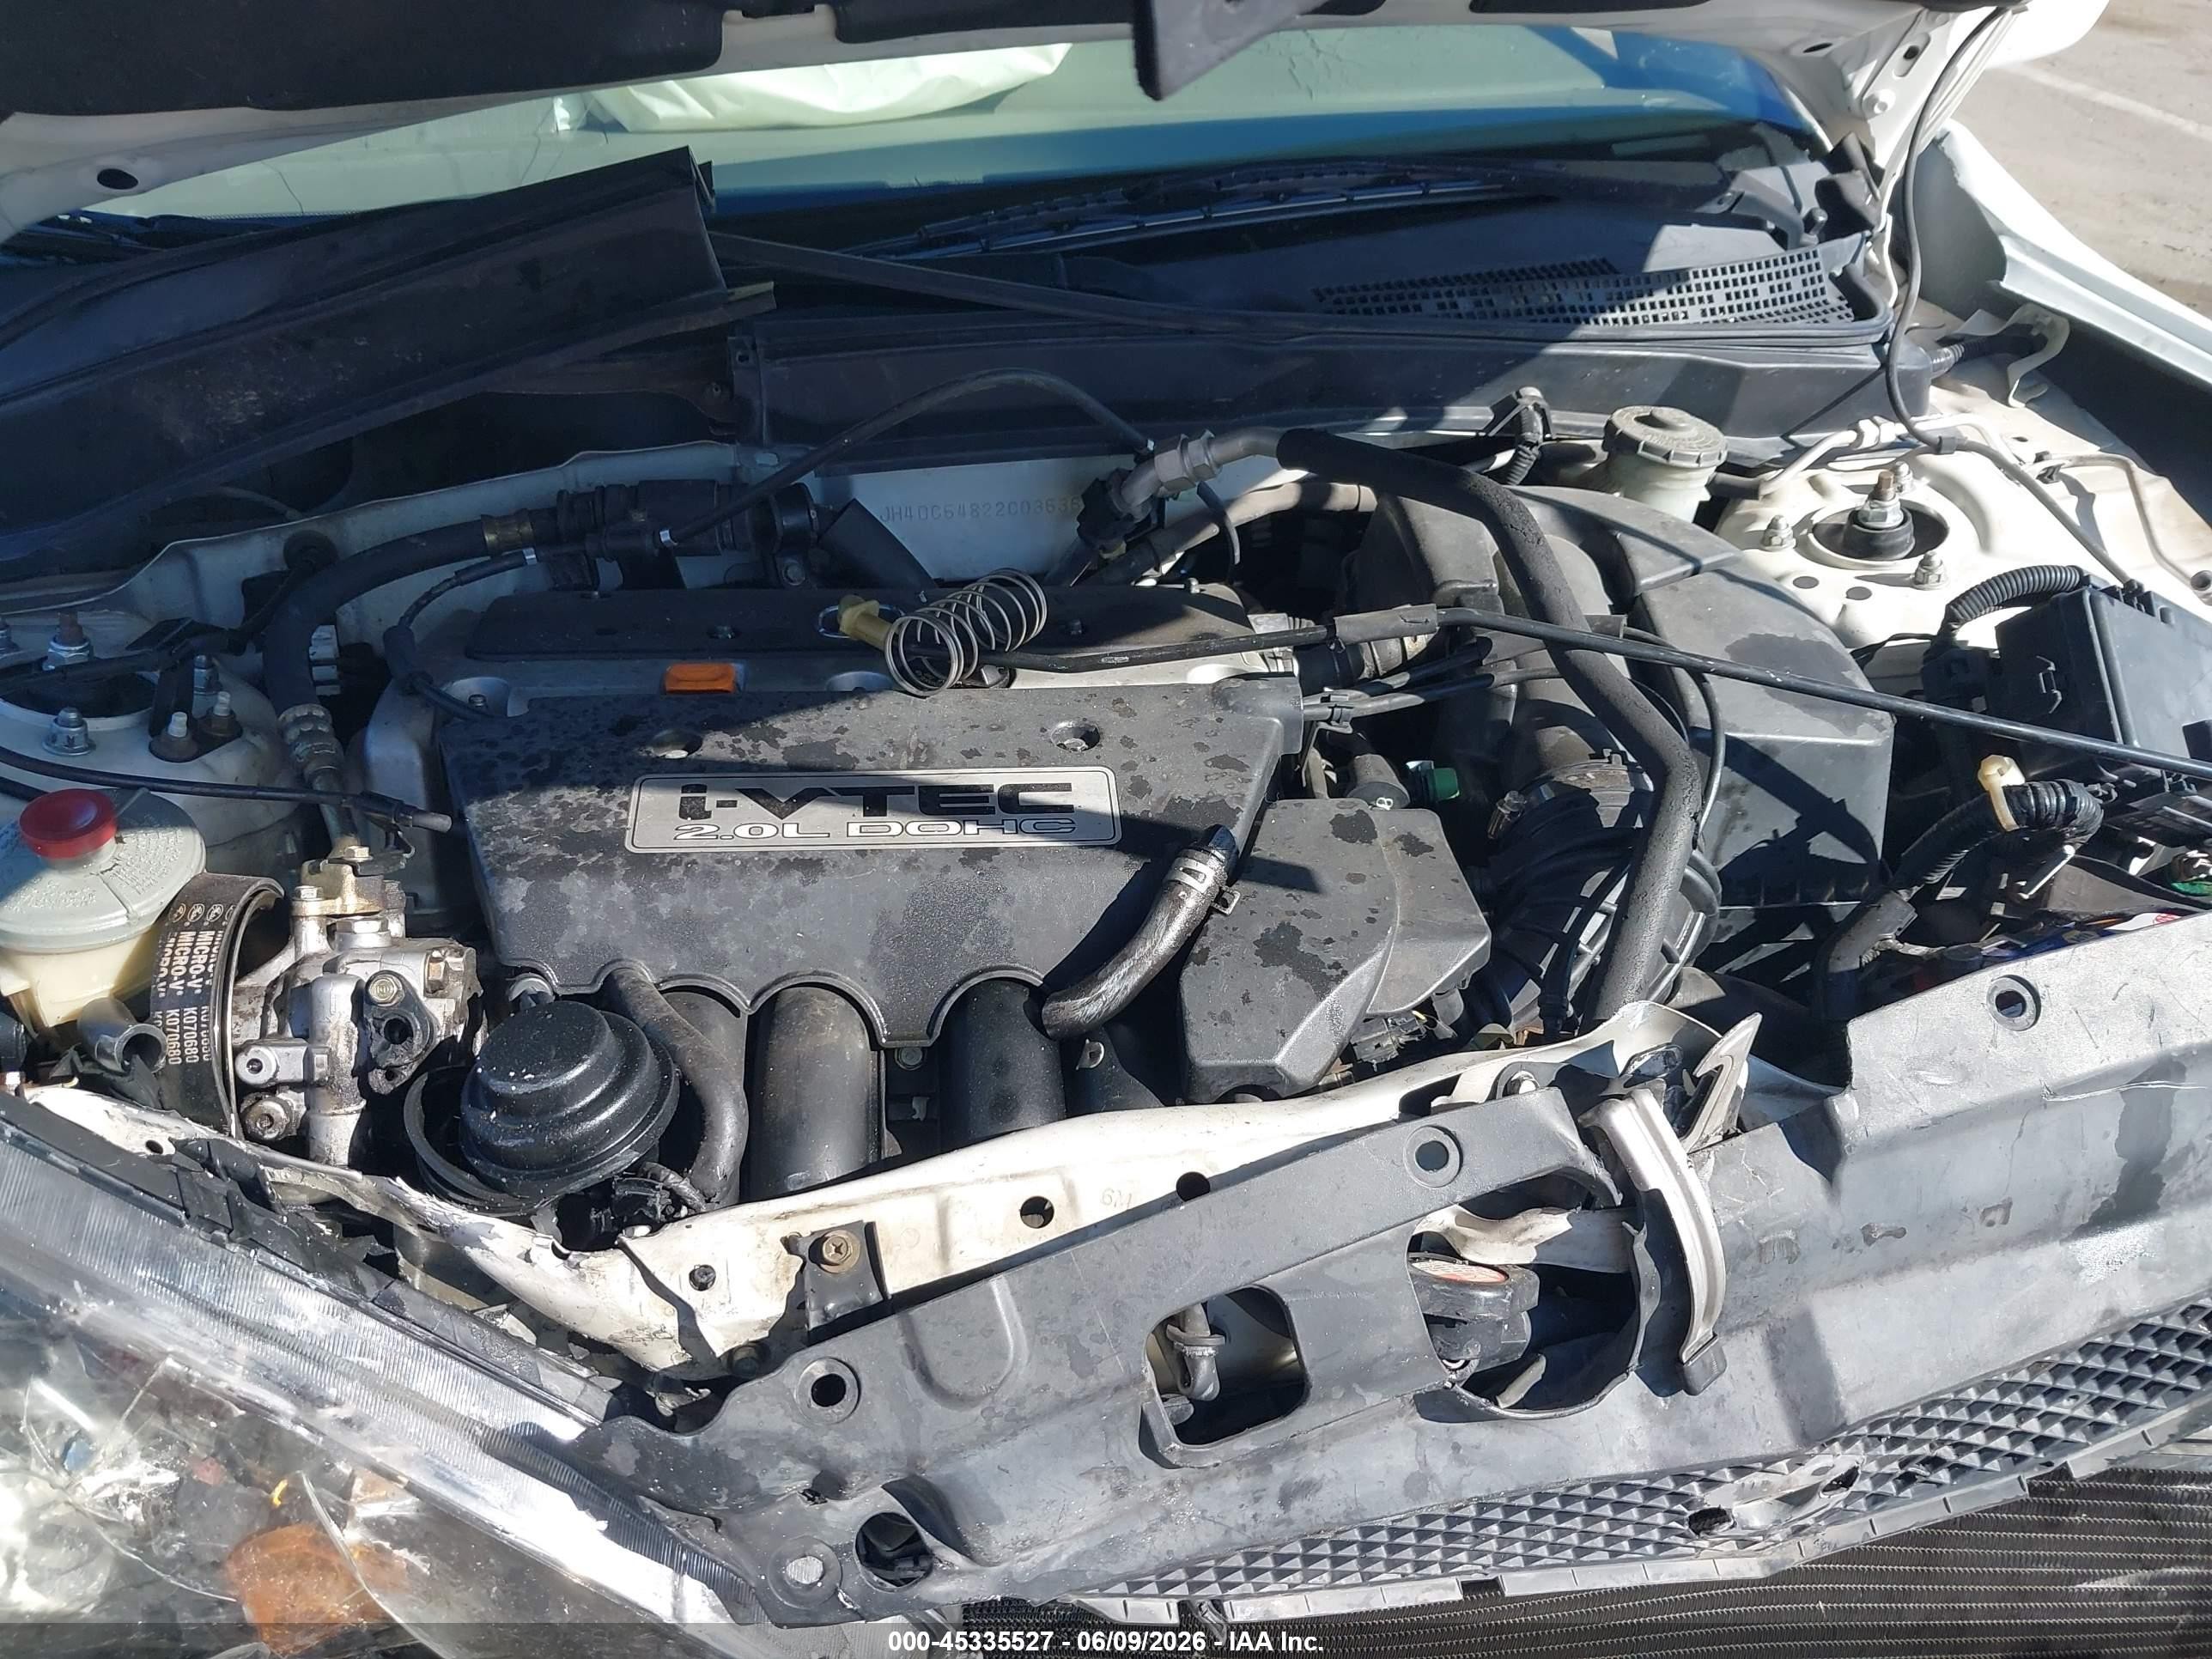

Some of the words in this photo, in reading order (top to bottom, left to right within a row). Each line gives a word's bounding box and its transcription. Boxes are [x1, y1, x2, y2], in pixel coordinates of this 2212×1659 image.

[674, 822, 830, 841] 2.0L
[846, 819, 1076, 838] DOHC
[166, 1008, 183, 1065] K070680
[183, 1006, 199, 1063] K070680
